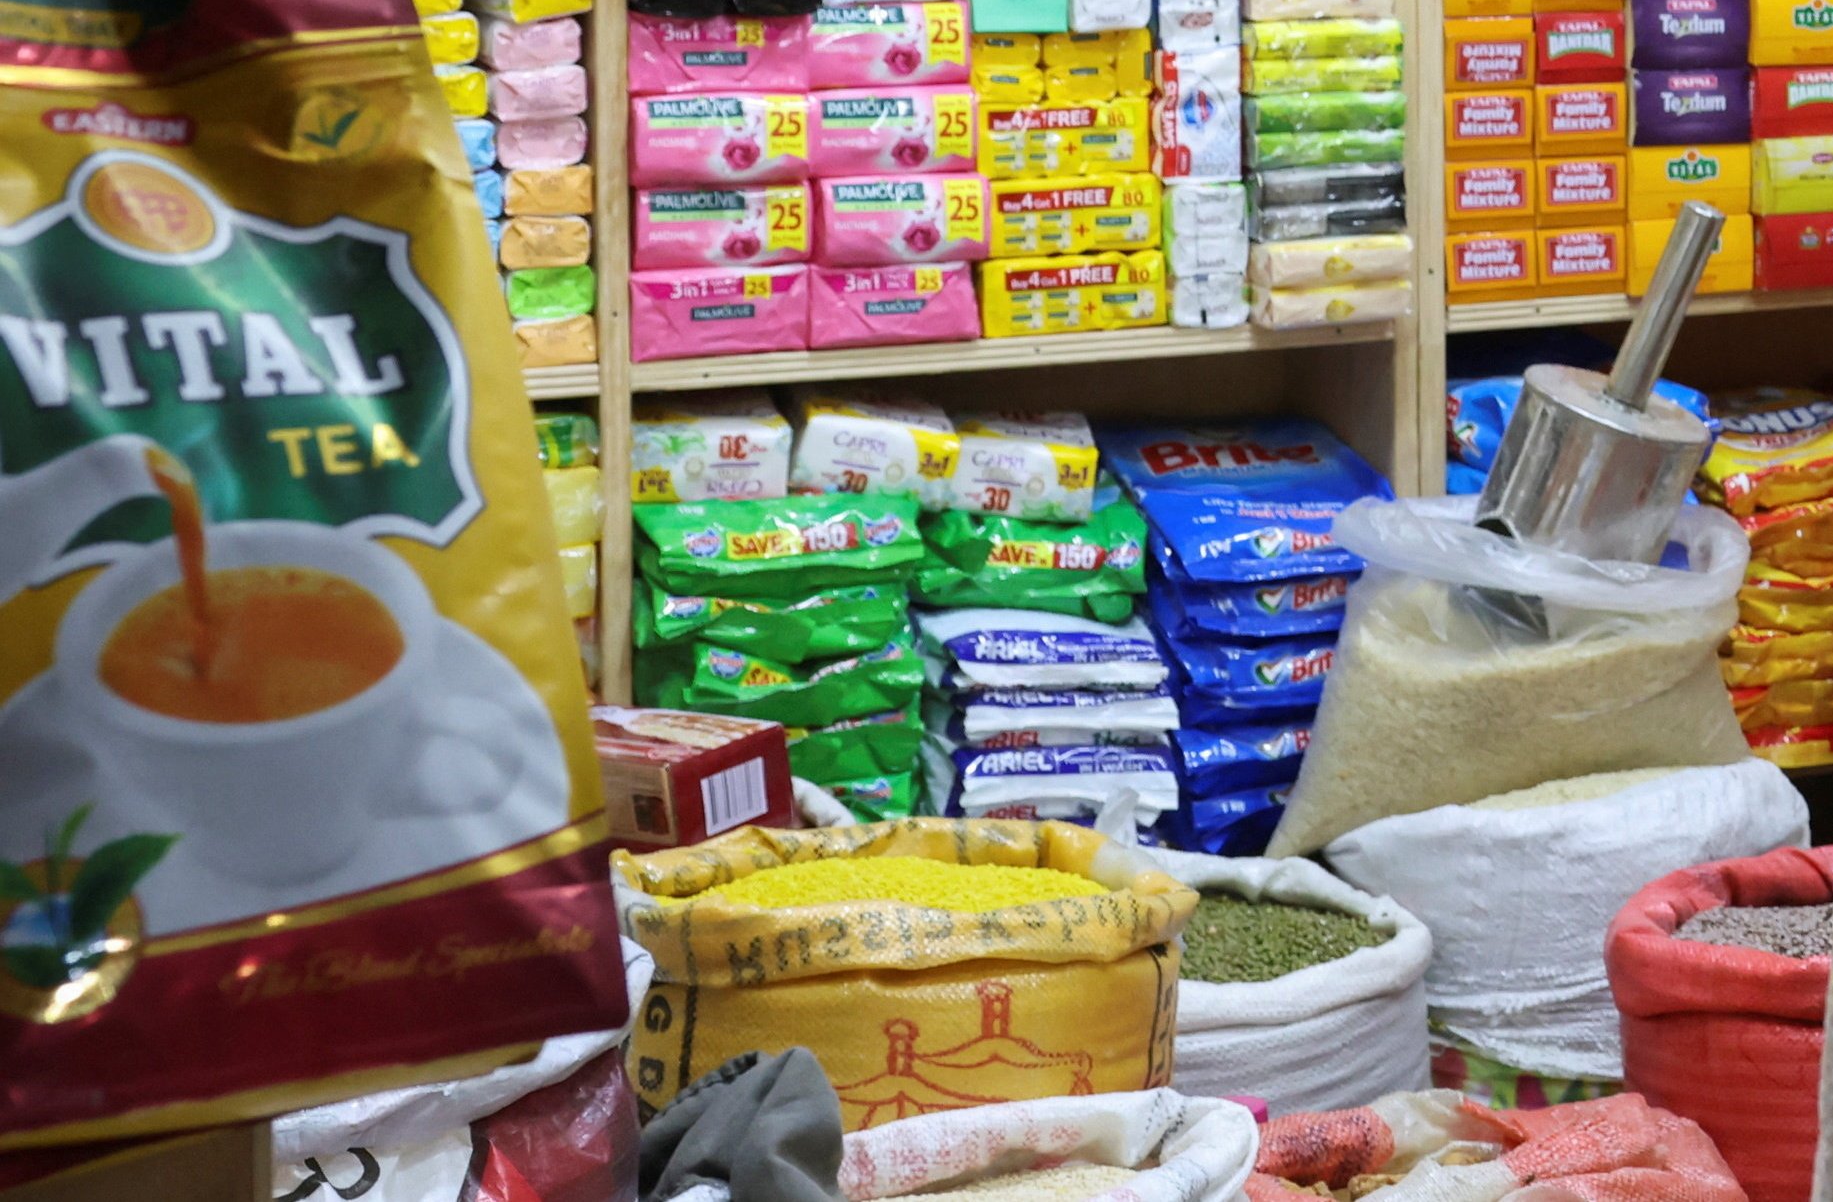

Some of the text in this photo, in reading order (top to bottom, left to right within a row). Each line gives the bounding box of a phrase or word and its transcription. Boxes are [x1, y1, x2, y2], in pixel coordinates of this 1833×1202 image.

[931, 20, 960, 44] 25
[1462, 106, 1516, 122] Family
[1552, 100, 1606, 116] Family
[771, 112, 801, 138] 25
[940, 112, 969, 138] 25
[1458, 120, 1519, 135] Mixture
[1550, 115, 1611, 130] Mixture
[1063, 187, 1110, 206] FREE
[1070, 265, 1114, 283] FREE
[2, 312, 405, 408] VITAL
[266, 425, 420, 478] TEA
[1055, 546, 1097, 568] 150
[981, 750, 1055, 774] ARIEL
